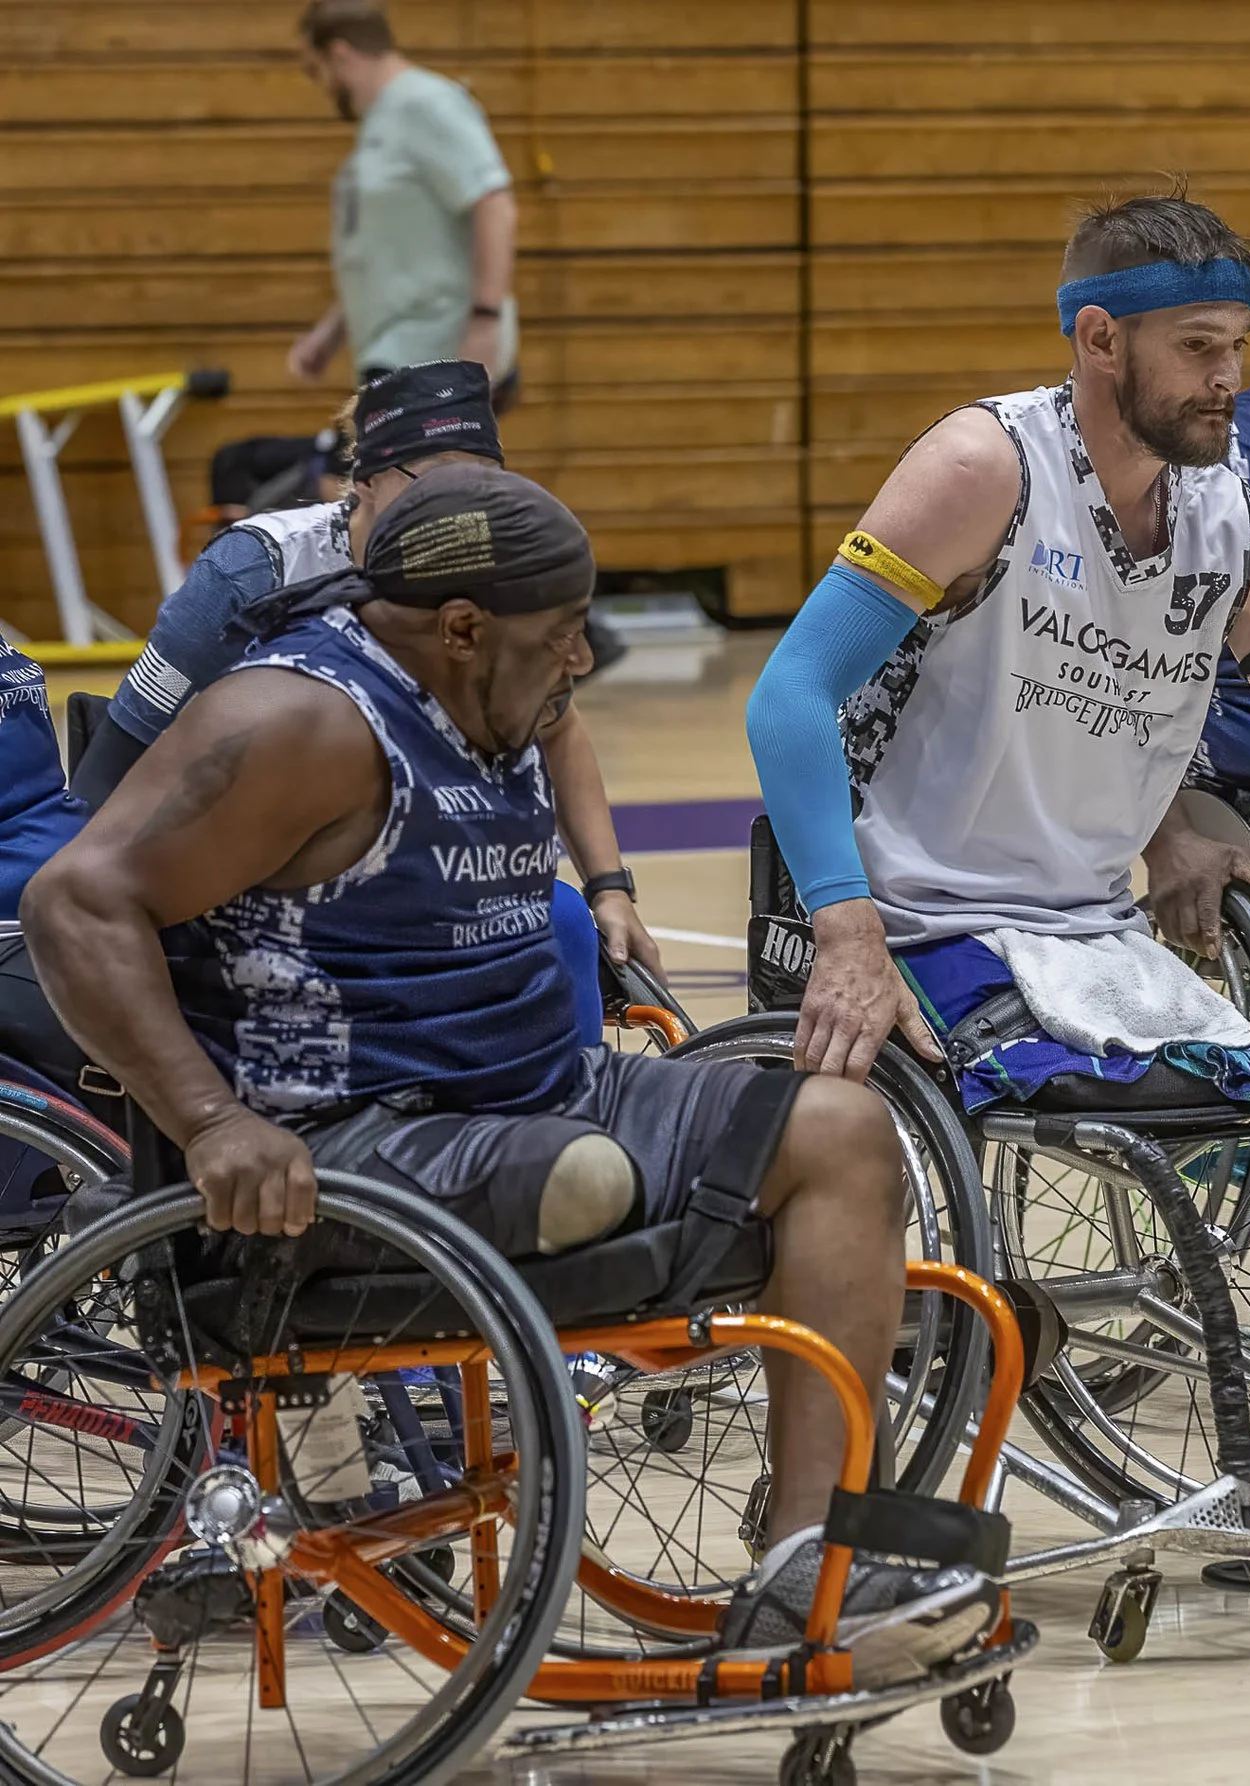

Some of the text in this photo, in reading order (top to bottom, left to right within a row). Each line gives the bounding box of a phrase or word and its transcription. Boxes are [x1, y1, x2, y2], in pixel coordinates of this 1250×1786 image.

[1164, 571, 1231, 636] 57
[1020, 597, 1213, 684] VALOR GAMES
[431, 844, 507, 882] VALOR
